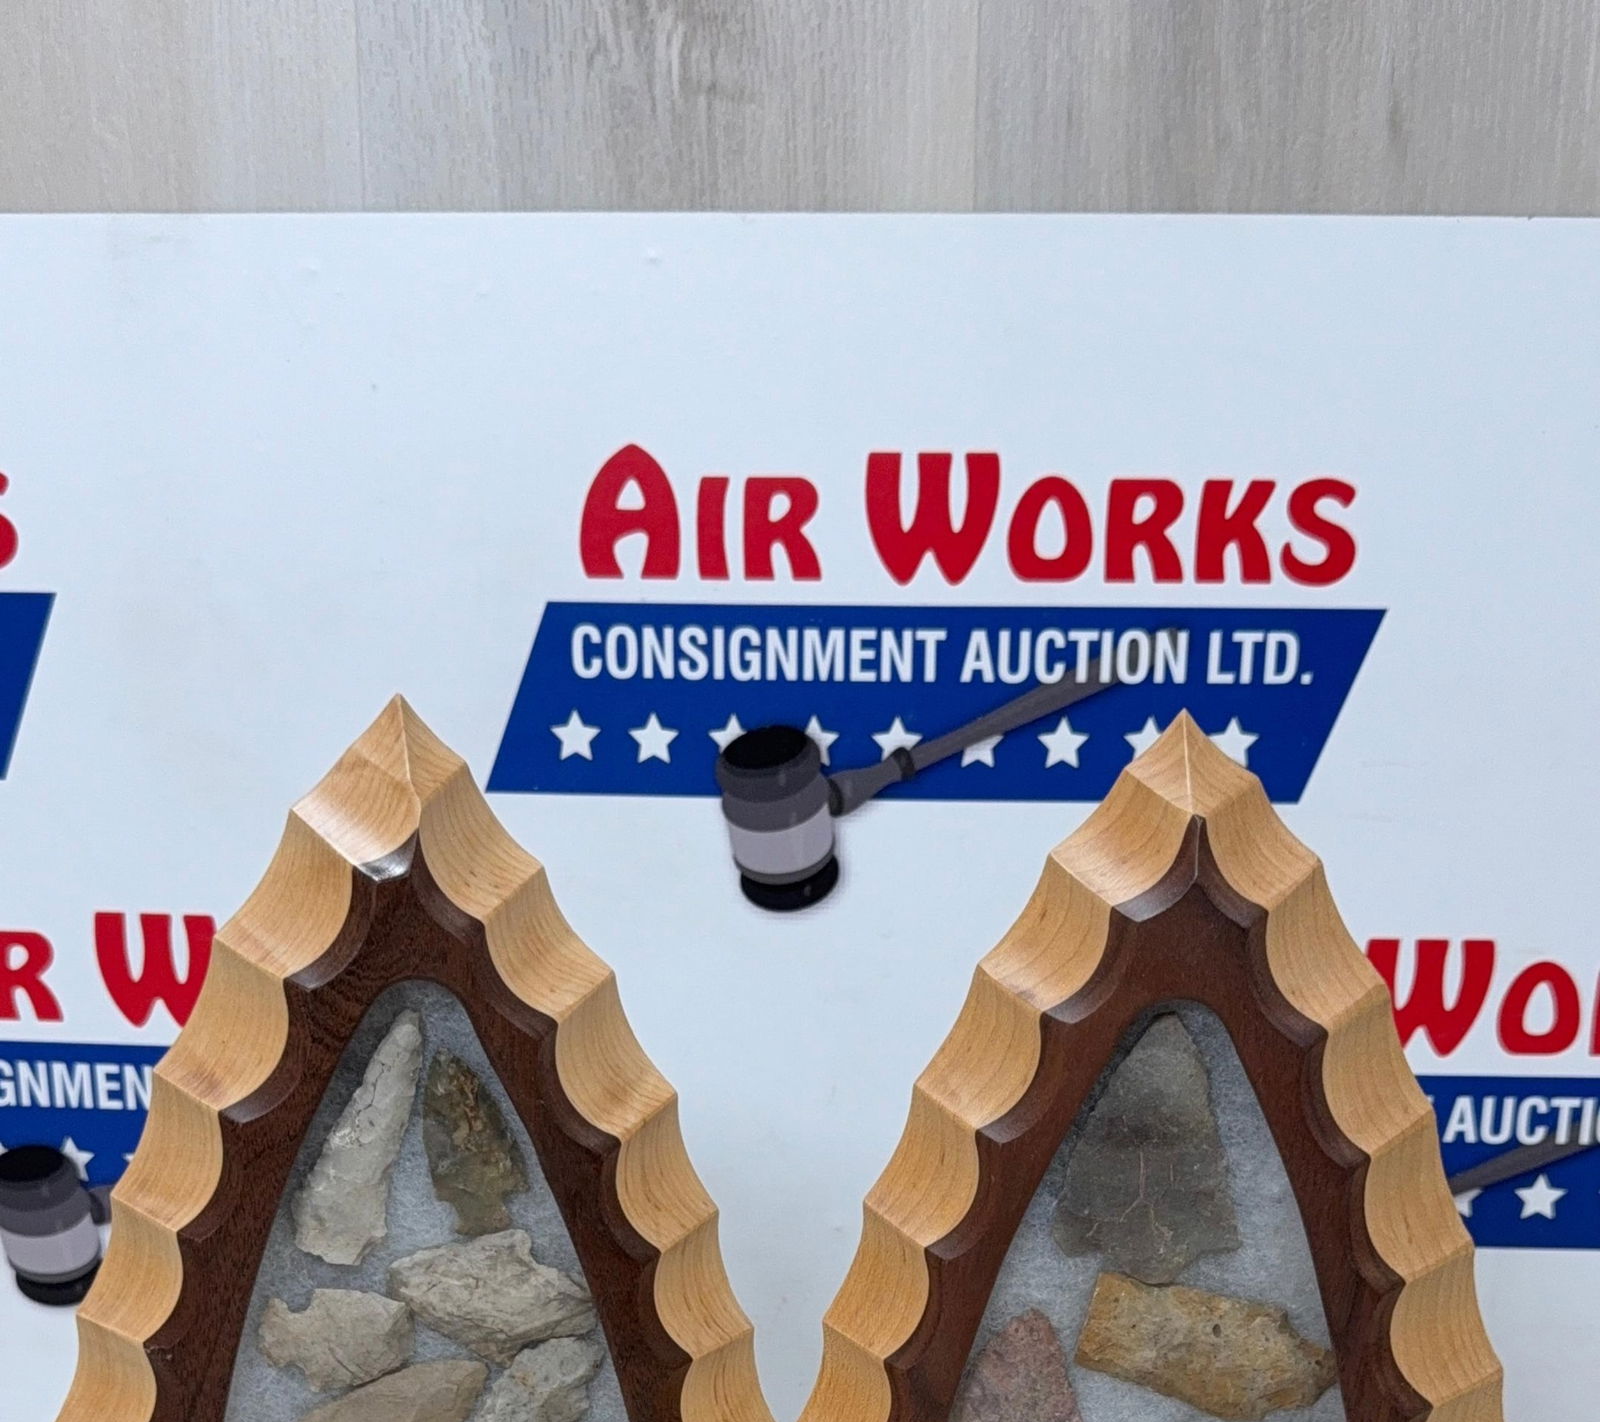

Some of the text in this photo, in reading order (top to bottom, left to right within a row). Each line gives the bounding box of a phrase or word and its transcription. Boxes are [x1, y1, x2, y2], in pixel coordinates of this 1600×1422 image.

[579, 443, 1356, 586] AIR WORKS
[571, 624, 1313, 686] CONSIGNMENT AUCTION LTD.
[1366, 938, 1600, 1058] WO
[1442, 1095, 1600, 1146] AUCTI
